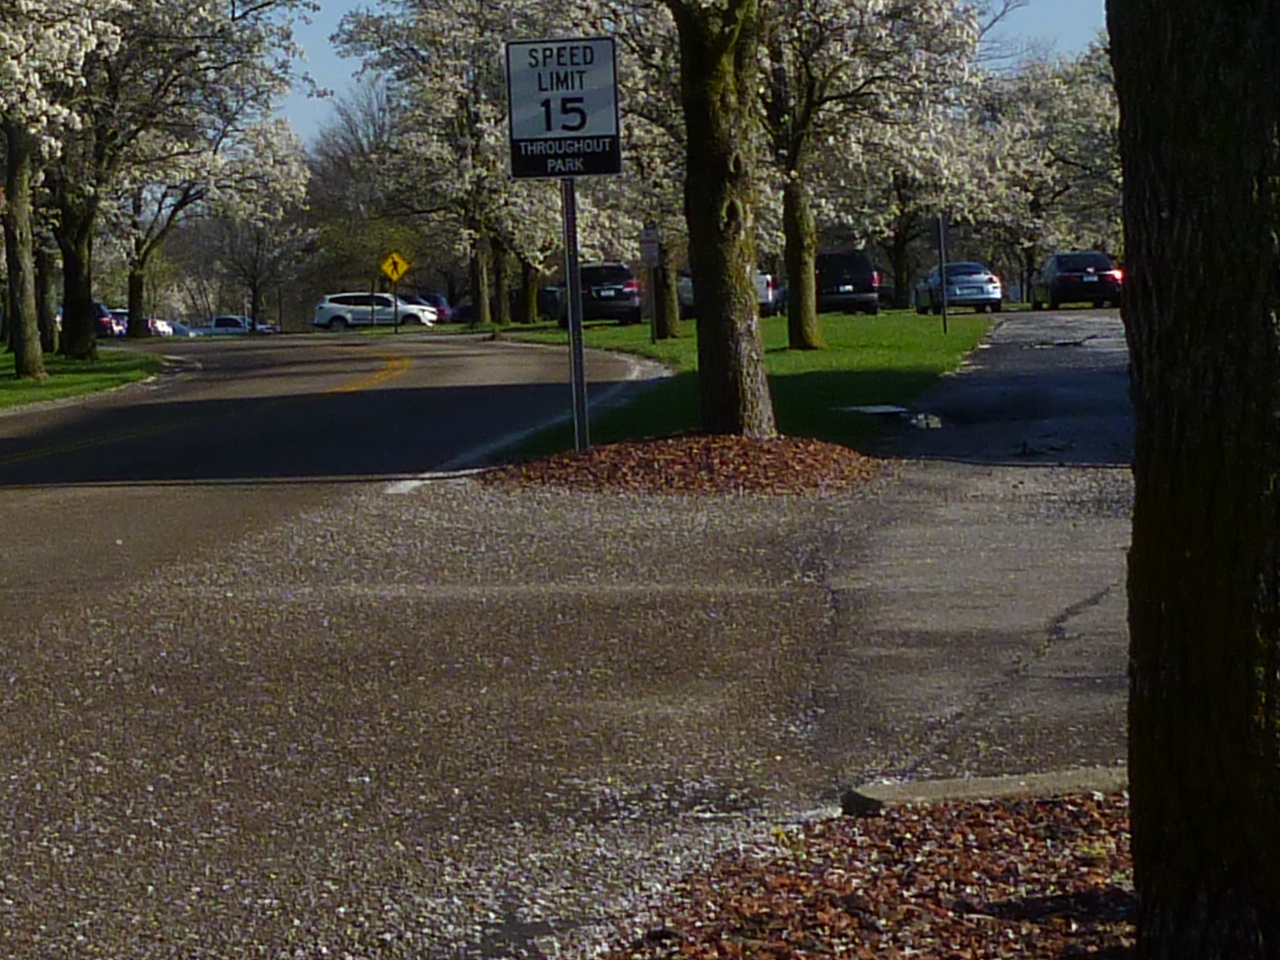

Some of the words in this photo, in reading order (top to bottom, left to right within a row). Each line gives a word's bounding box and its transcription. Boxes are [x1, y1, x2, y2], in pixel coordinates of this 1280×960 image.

[528, 46, 594, 68] SPEED
[538, 71, 587, 92] LIMIT
[540, 97, 587, 132] 15
[519, 138, 612, 156] THROUGHOUT
[547, 158, 584, 172] PARK
